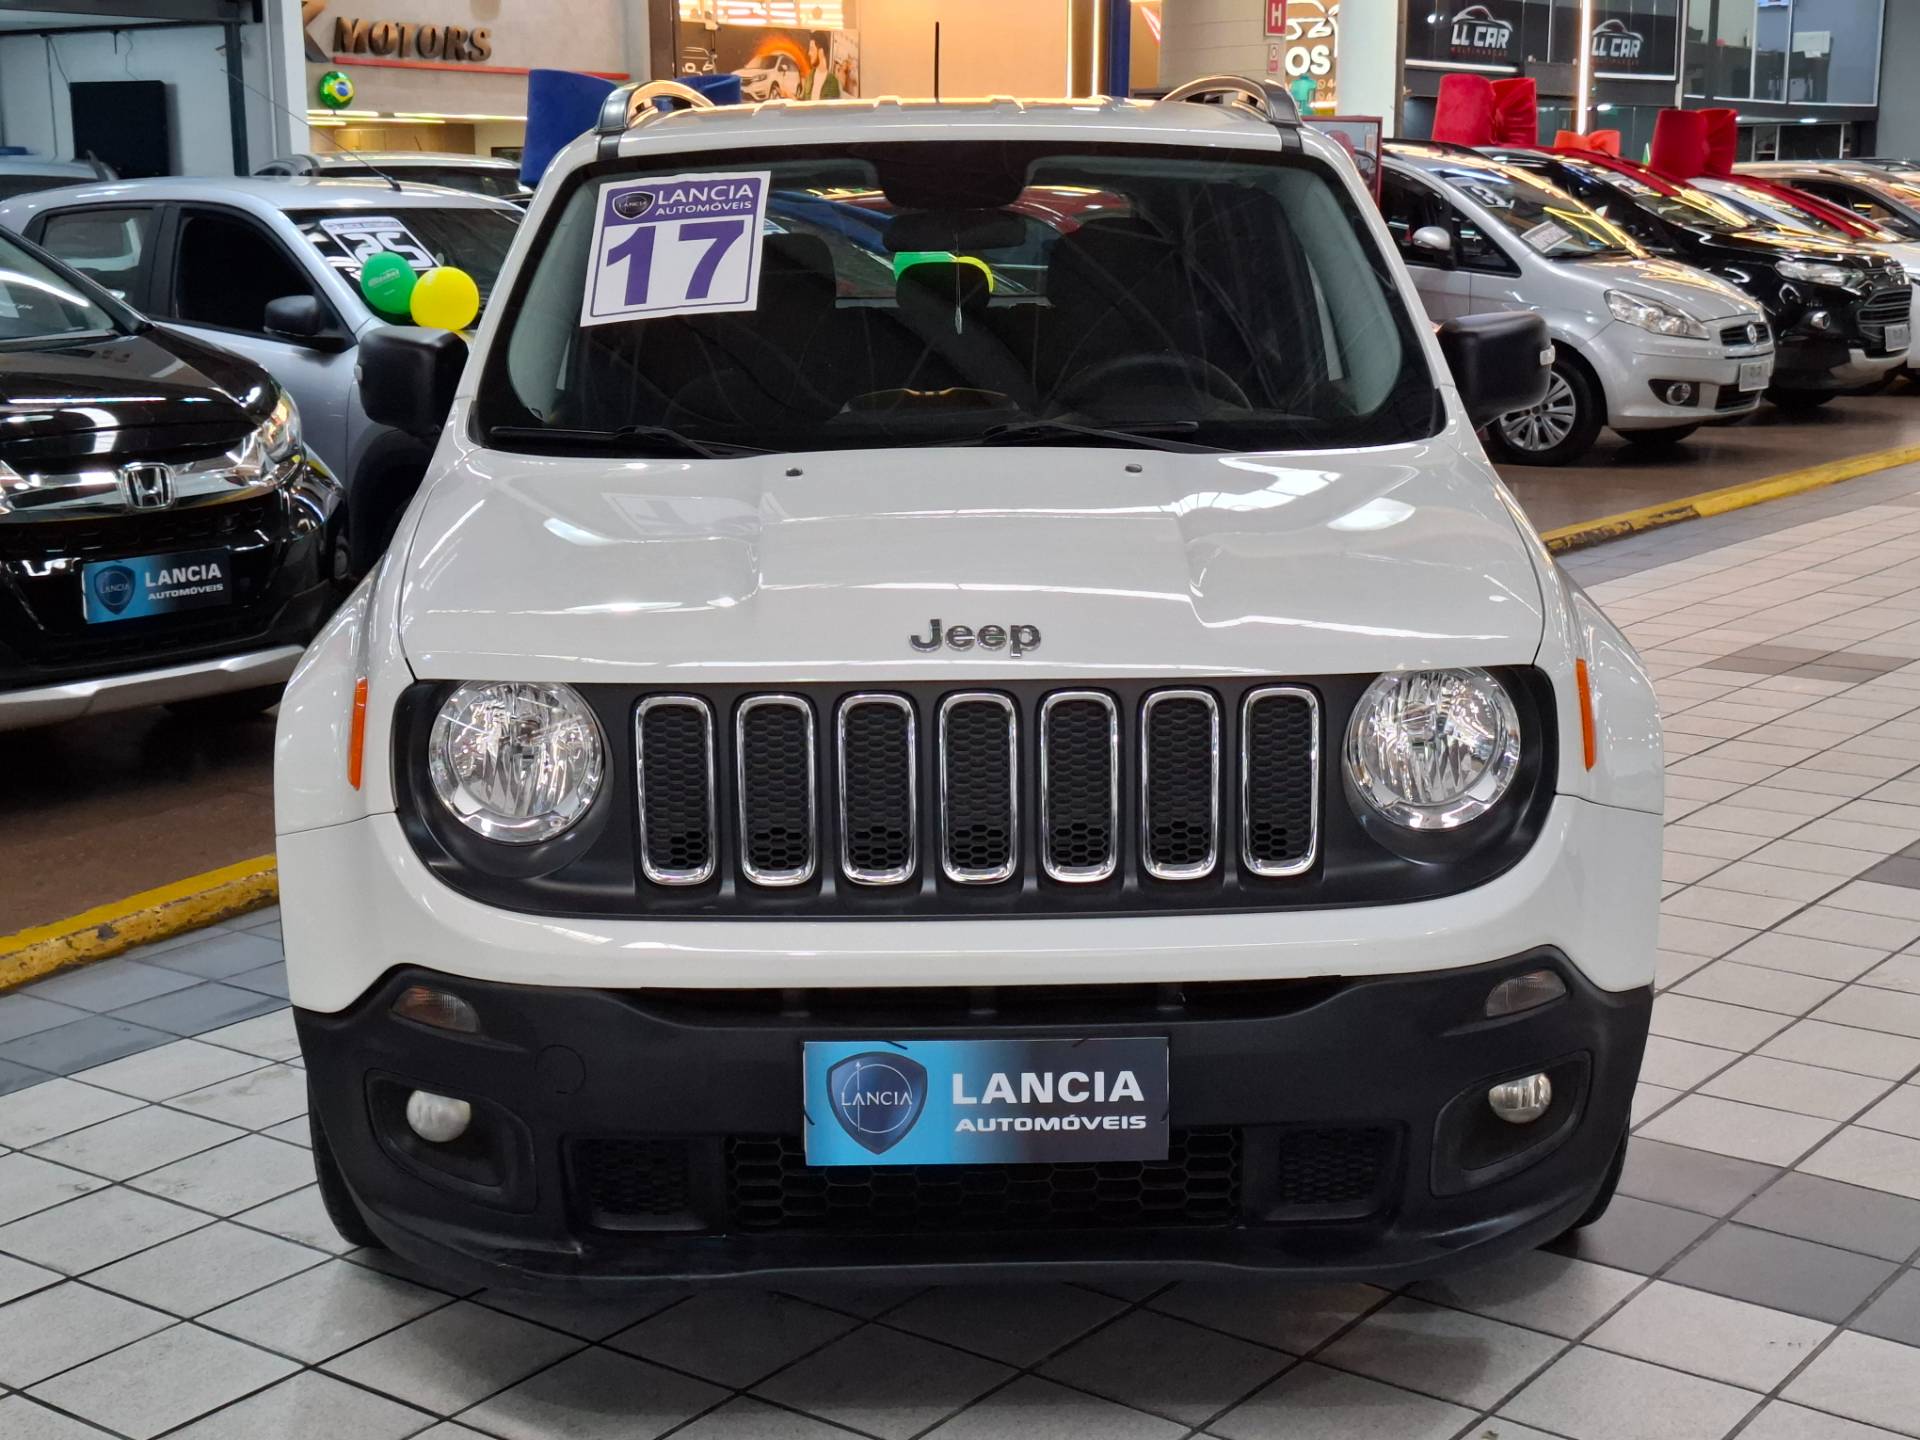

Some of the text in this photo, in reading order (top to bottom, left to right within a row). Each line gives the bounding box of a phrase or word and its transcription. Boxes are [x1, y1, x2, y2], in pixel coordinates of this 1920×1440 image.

[333, 16, 492, 61] MOTORS
[1451, 24, 1510, 49] LL CAR
[1610, 38, 1641, 58] CAR
[657, 184, 754, 205] LANCIA
[655, 200, 752, 216] AUTOMÓVEIS
[606, 220, 745, 306] 17
[144, 563, 222, 588] LANCIA
[101, 582, 130, 595] LANCIA
[147, 583, 224, 601] AUTOMÓVEIS
[908, 618, 1042, 659] Jeep
[952, 1069, 1145, 1106] LANCIA
[840, 1090, 913, 1107] LANCIA
[954, 1113, 1147, 1133] AUTOMÓVEIS
